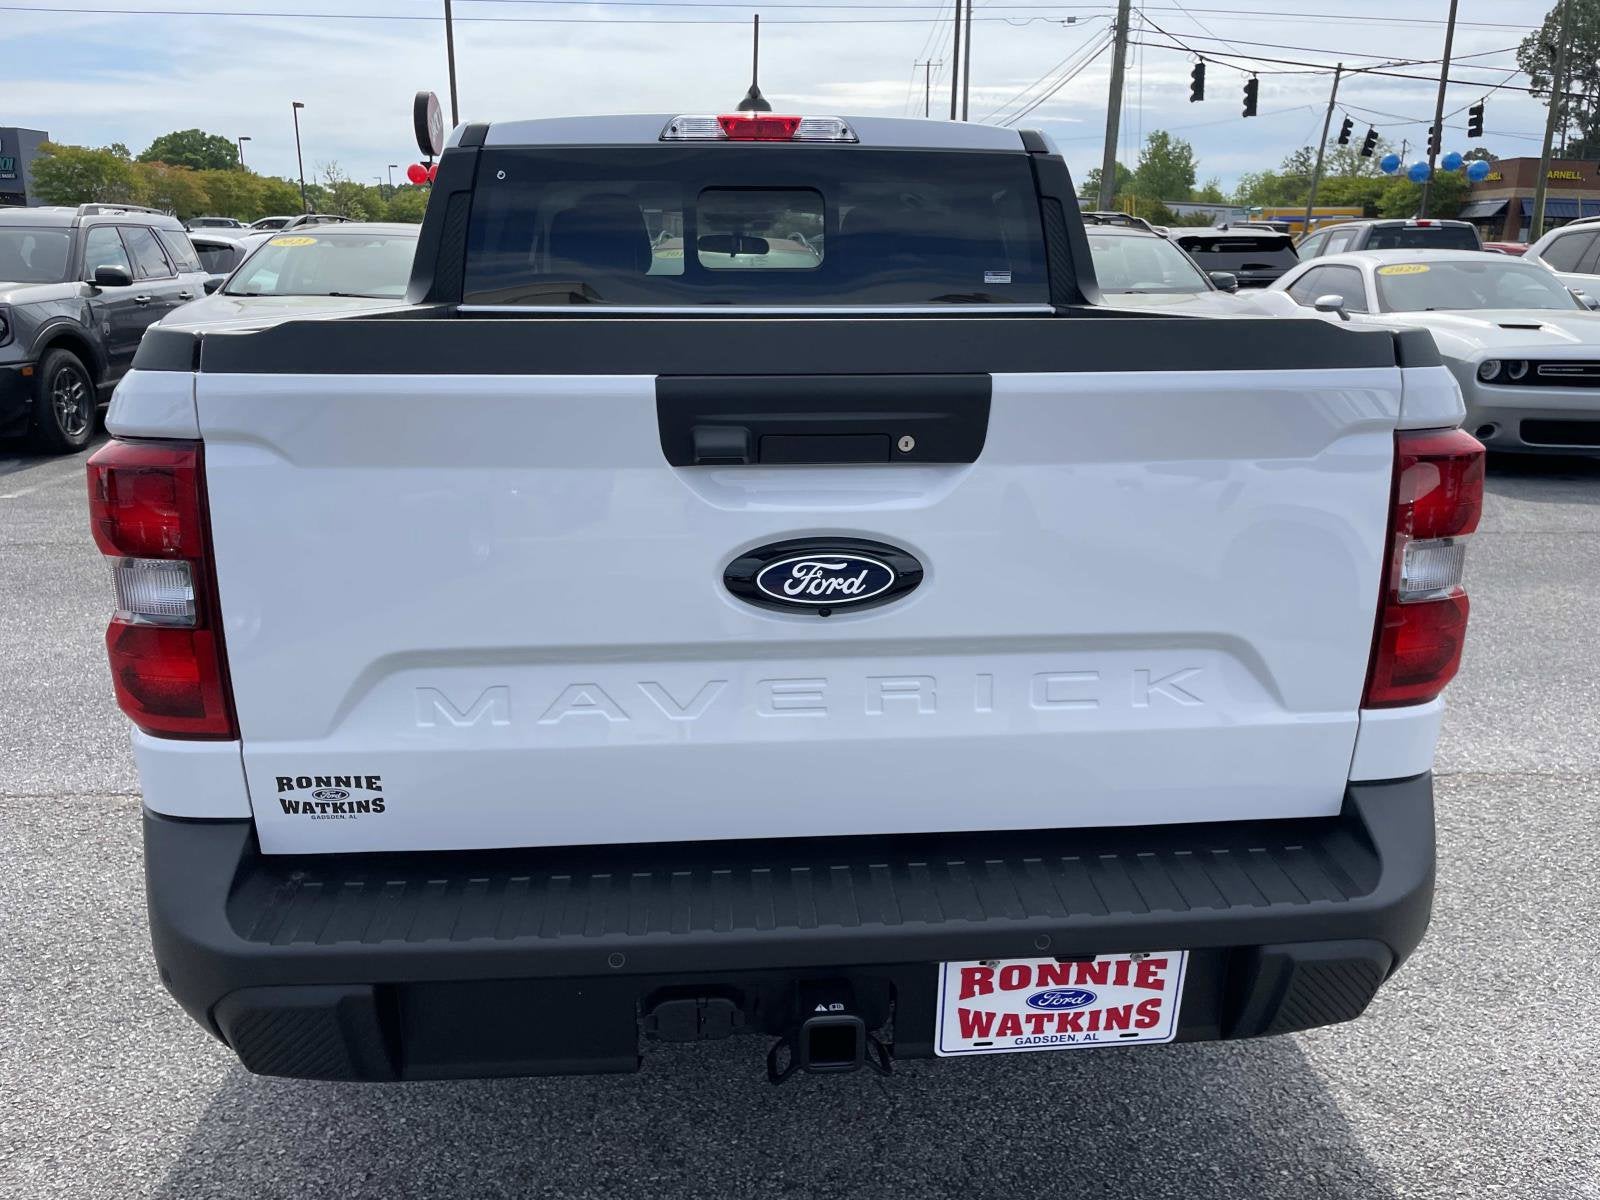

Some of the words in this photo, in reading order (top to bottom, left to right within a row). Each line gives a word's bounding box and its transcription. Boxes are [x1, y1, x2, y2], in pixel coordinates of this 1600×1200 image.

[783, 561, 869, 596] Ford
[415, 667, 1205, 728] MAVERICK
[275, 775, 383, 793] RONNIE
[320, 790, 342, 800] Ford
[279, 797, 386, 815] WATKINS
[959, 958, 1168, 1001] RONNIE
[1037, 990, 1088, 1007] Ford
[957, 998, 1163, 1039] WATKINS
[1014, 1034, 1080, 1046] GADSDEN,
[1083, 1032, 1100, 1042] AL
